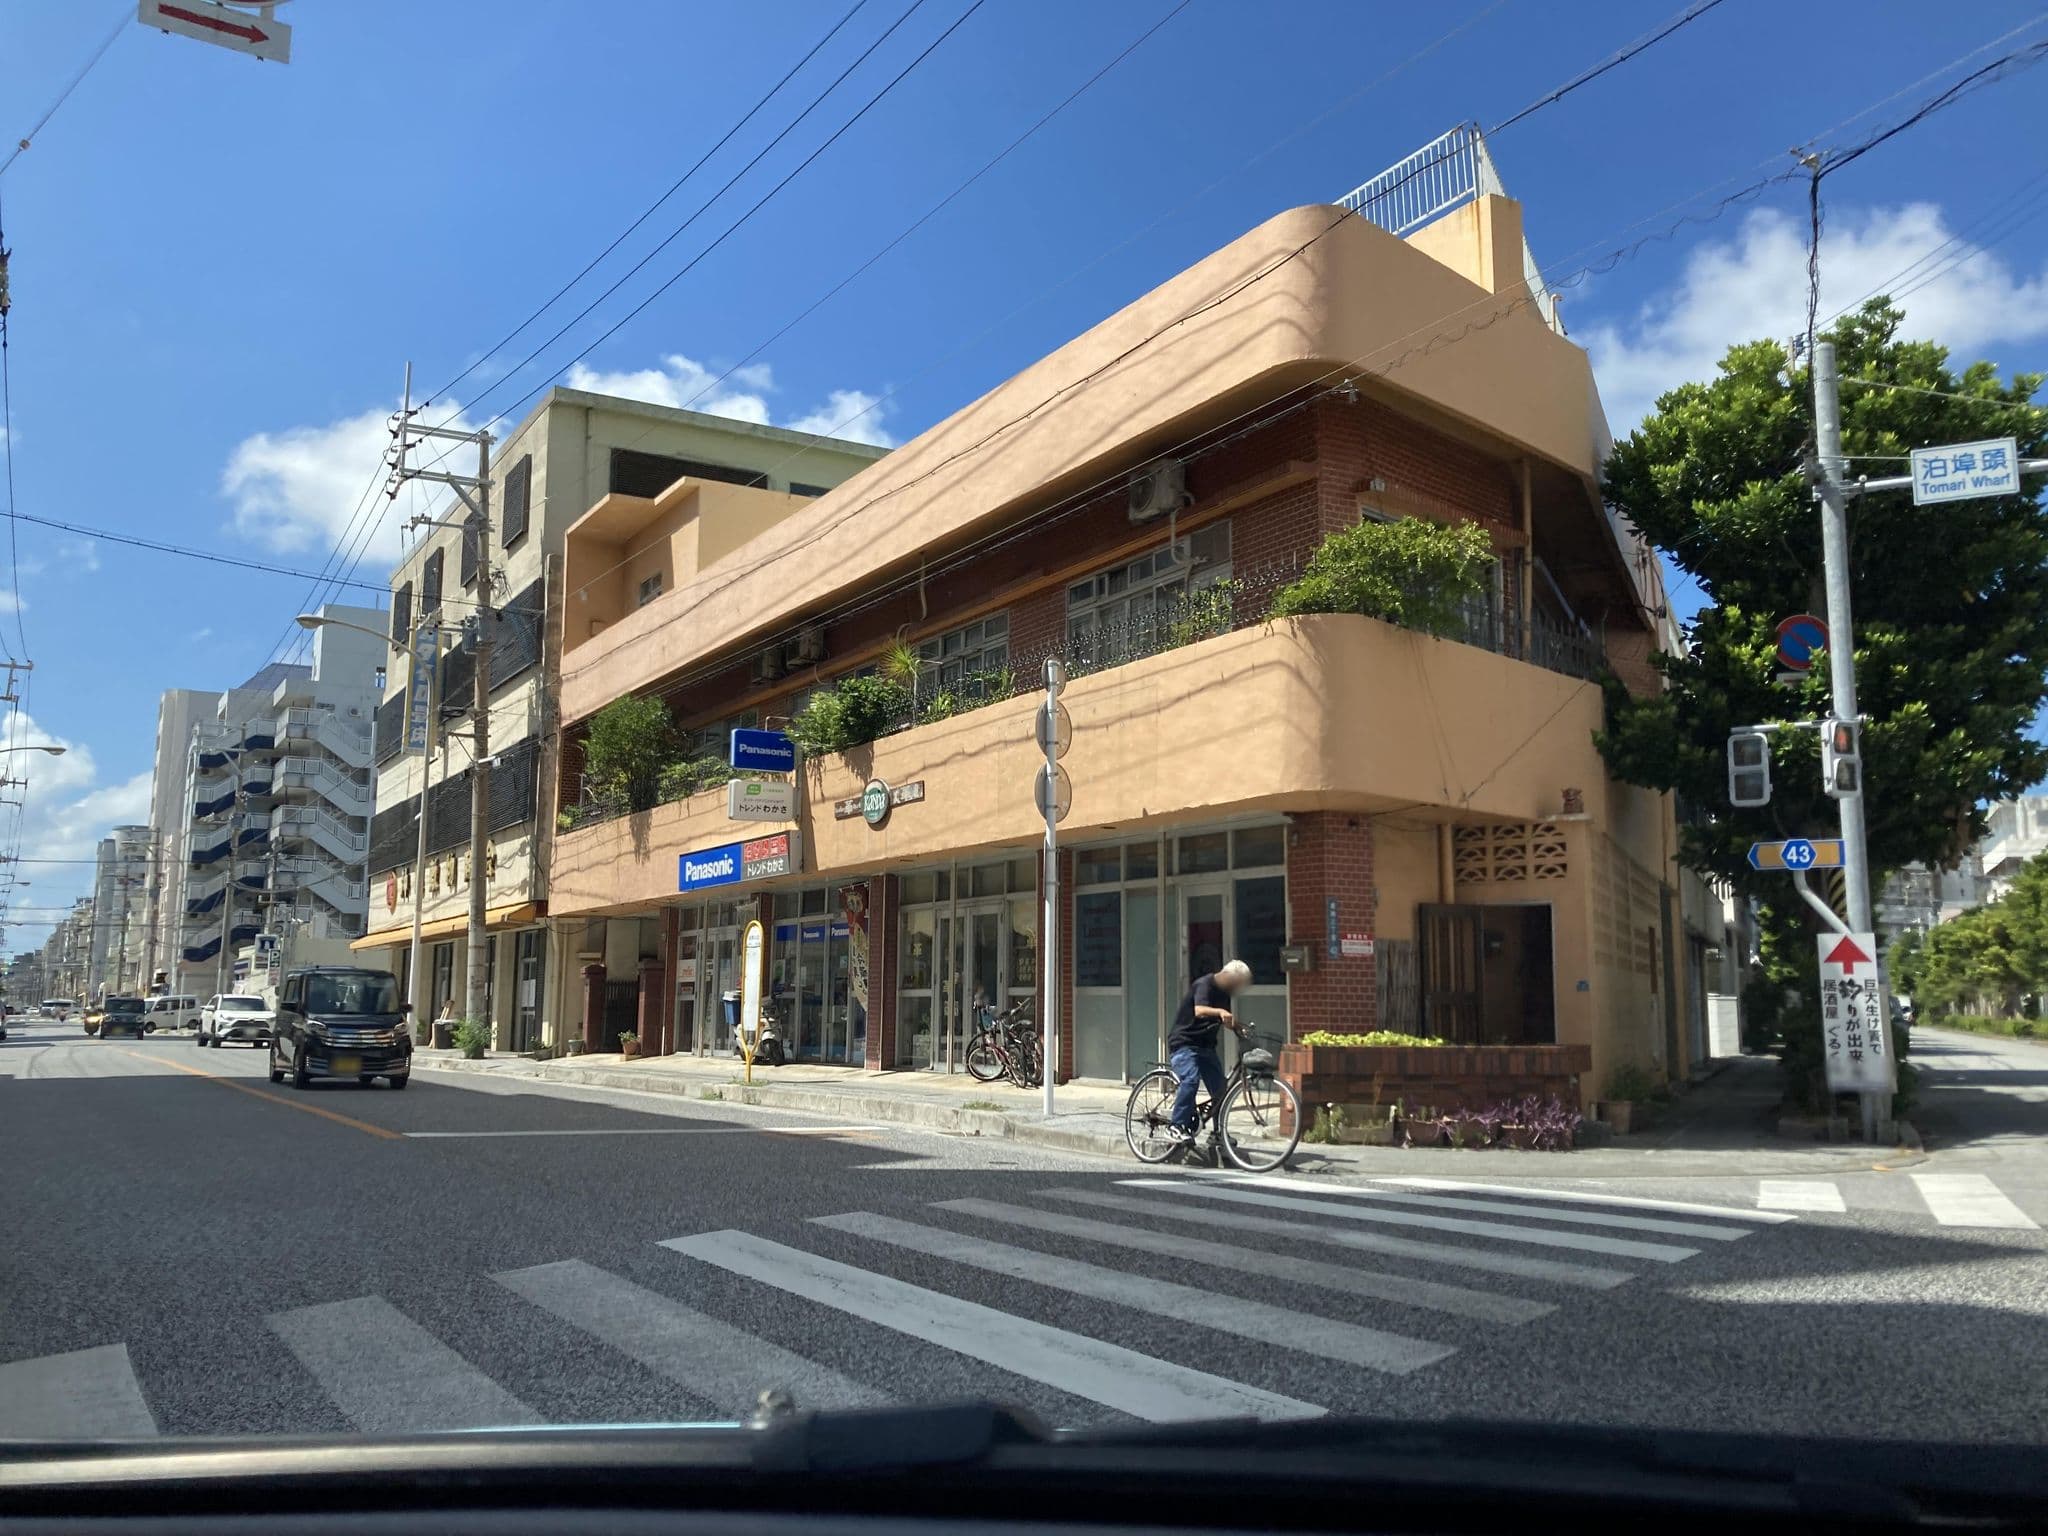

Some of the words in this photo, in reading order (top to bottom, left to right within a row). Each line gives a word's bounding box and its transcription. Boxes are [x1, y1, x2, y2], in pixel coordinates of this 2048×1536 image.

[1923, 448, 2008, 479] 泊埠頭
[1921, 480, 1966, 494] Tomari
[1971, 473, 2011, 488] Wharf
[739, 744, 792, 757] Panasonic
[739, 804, 787, 814] トレンドわかさ
[1786, 847, 1811, 863] 43
[685, 853, 734, 882] Panasonic
[747, 859, 784, 877] トレンドわかさ
[1823, 980, 1839, 1019] 居酒屋
